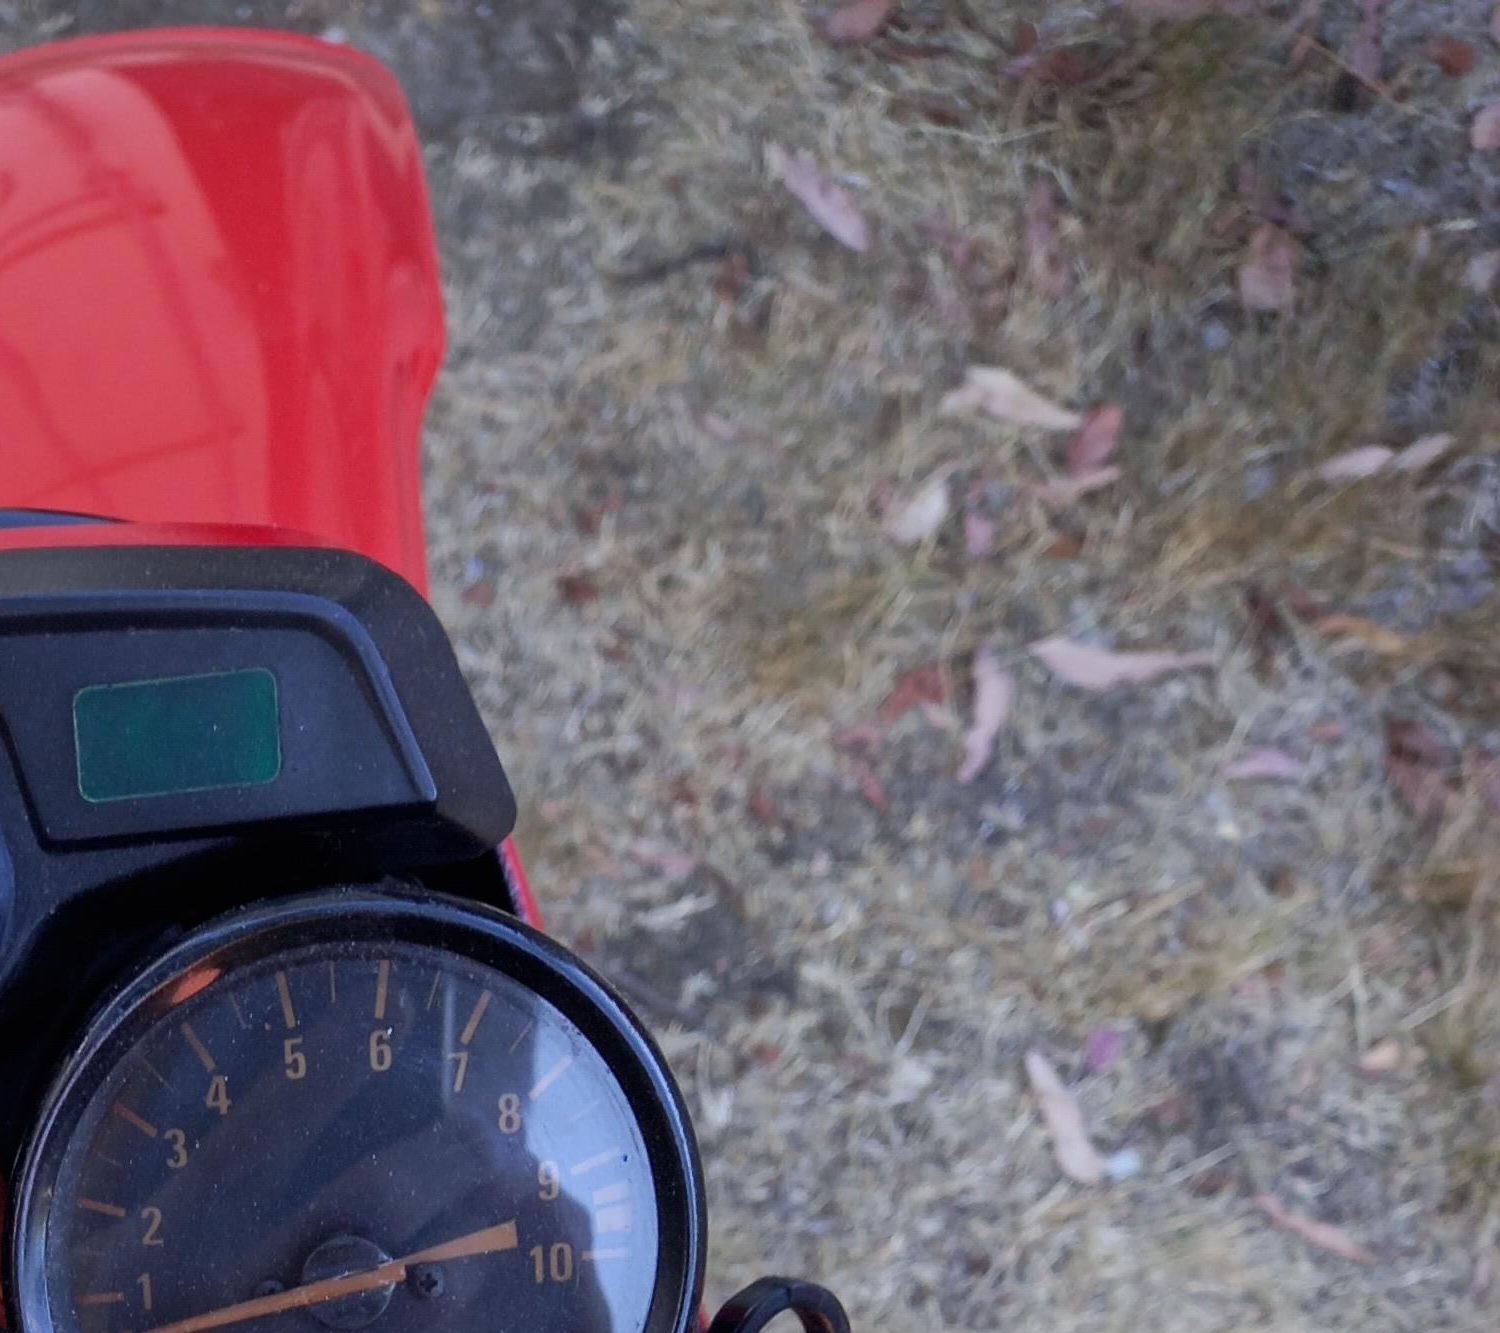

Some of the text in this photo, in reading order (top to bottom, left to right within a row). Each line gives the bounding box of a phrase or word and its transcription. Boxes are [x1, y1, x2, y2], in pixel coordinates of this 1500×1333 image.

[283, 1039, 307, 1080] 5
[368, 1029, 392, 1072] 6
[205, 1074, 232, 1115] 4
[446, 1054, 469, 1094] 7
[497, 1092, 523, 1135] 8
[164, 1128, 189, 1169] 3
[536, 1161, 561, 1201] 9
[140, 1206, 164, 1246] 2
[529, 1243, 574, 1285] 10
[136, 1273, 153, 1311] 1
